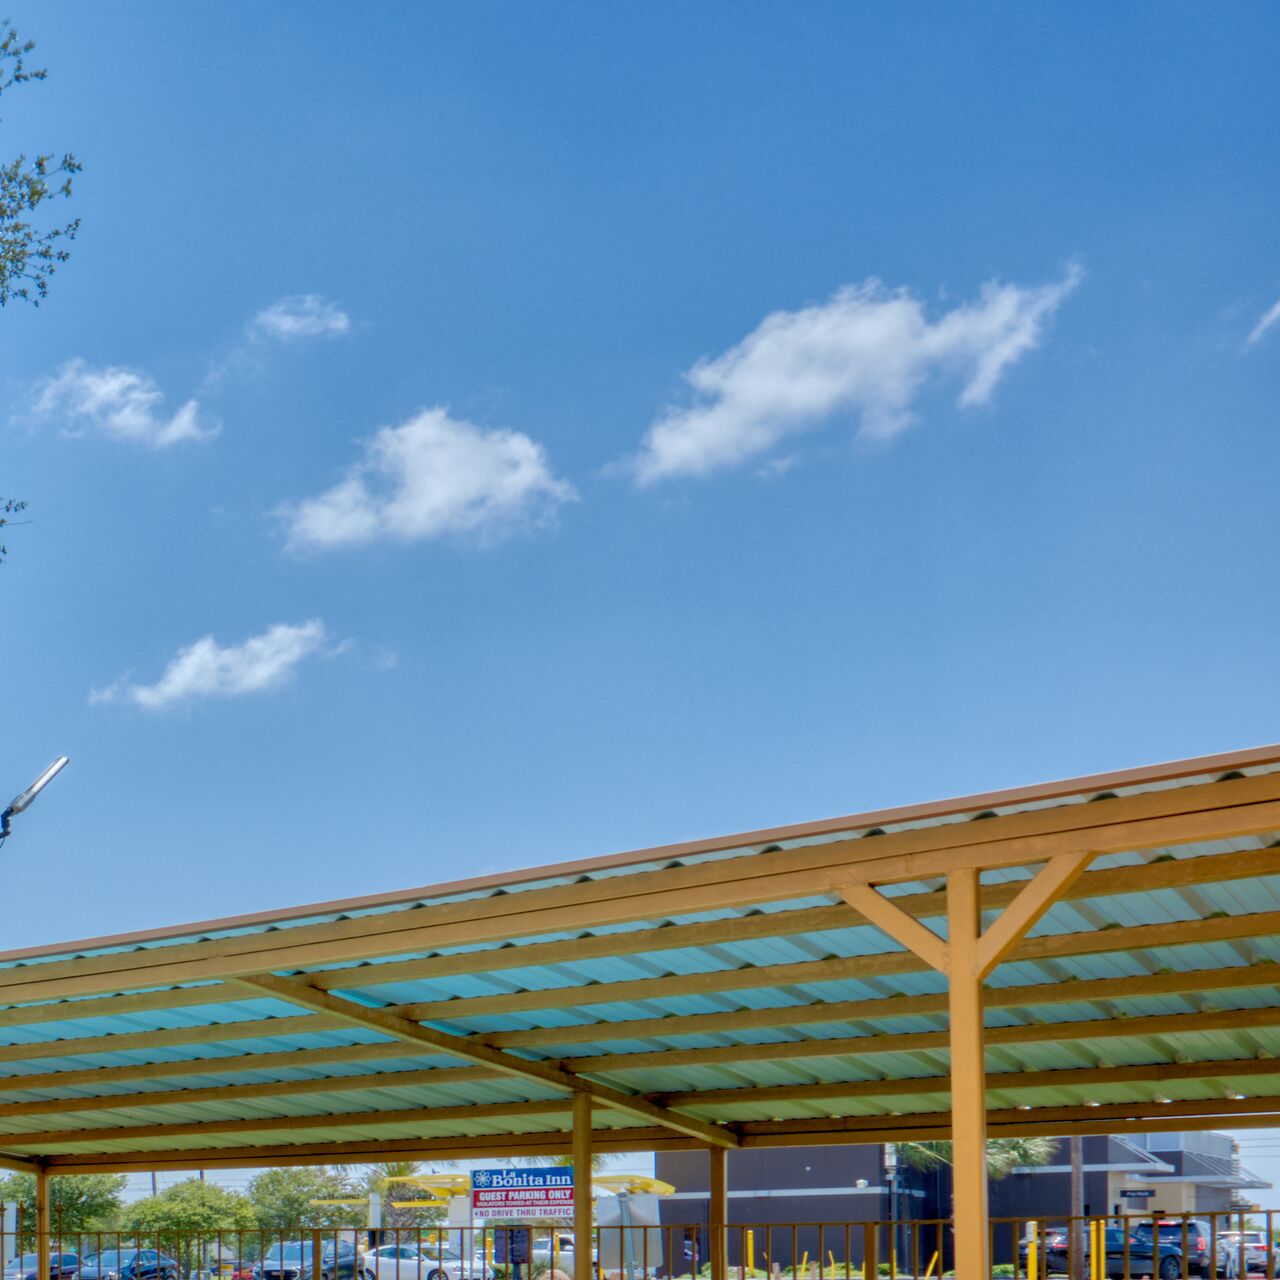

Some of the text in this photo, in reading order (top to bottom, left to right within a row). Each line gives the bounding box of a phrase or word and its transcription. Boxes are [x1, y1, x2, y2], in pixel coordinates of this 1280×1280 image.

[503, 1170, 515, 1178] La
[492, 1174, 571, 1187] Bonita Inn
[480, 1190, 571, 1200] GUEST PARKING ONLY
